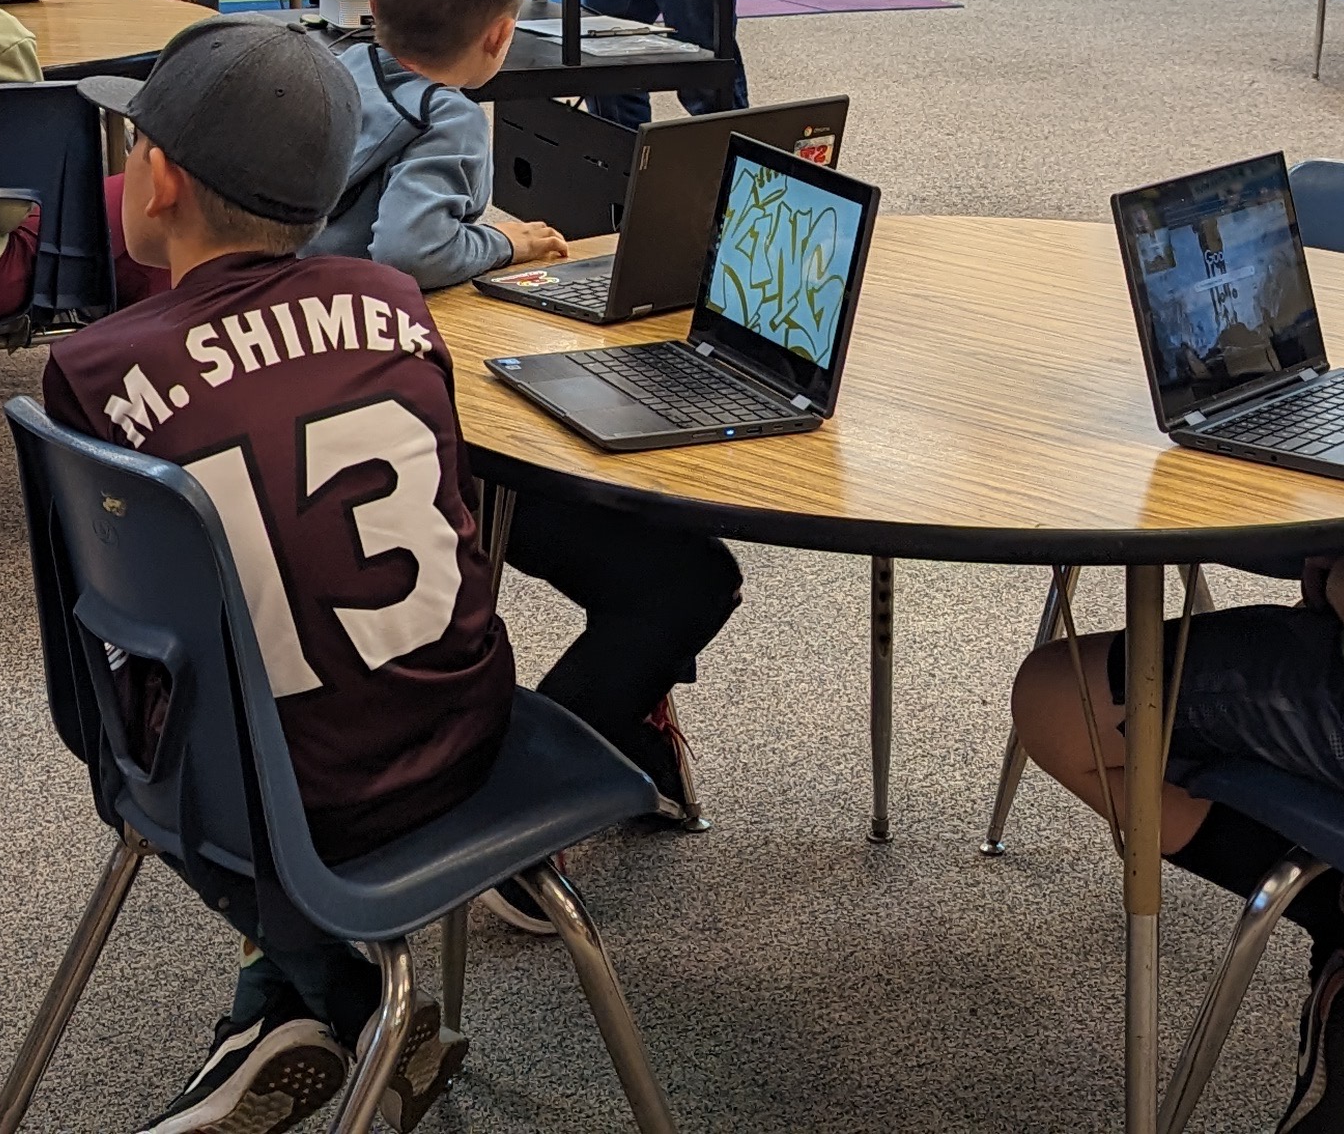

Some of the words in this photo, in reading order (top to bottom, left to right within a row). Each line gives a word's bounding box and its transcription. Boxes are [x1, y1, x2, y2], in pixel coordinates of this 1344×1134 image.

[104, 363, 190, 449] M.
[185, 294, 433, 387] SHIMEK
[183, 399, 463, 698] 13
